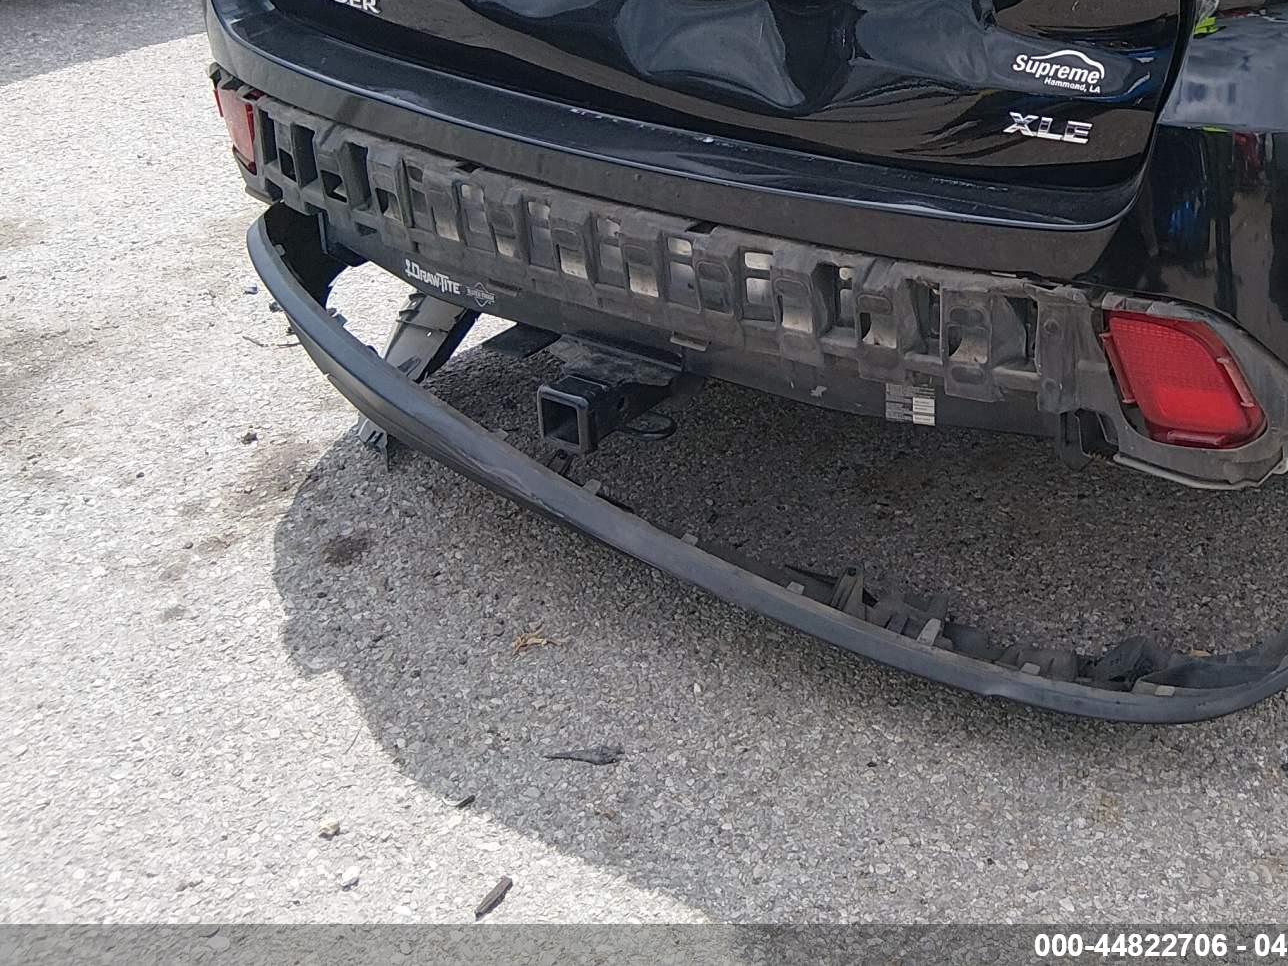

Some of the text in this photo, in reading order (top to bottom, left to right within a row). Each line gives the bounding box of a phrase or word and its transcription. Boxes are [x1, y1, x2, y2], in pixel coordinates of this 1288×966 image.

[1012, 54, 1100, 84] Supreme
[1044, 77, 1101, 94] Hammond, LA
[1002, 111, 1093, 144] XLE
